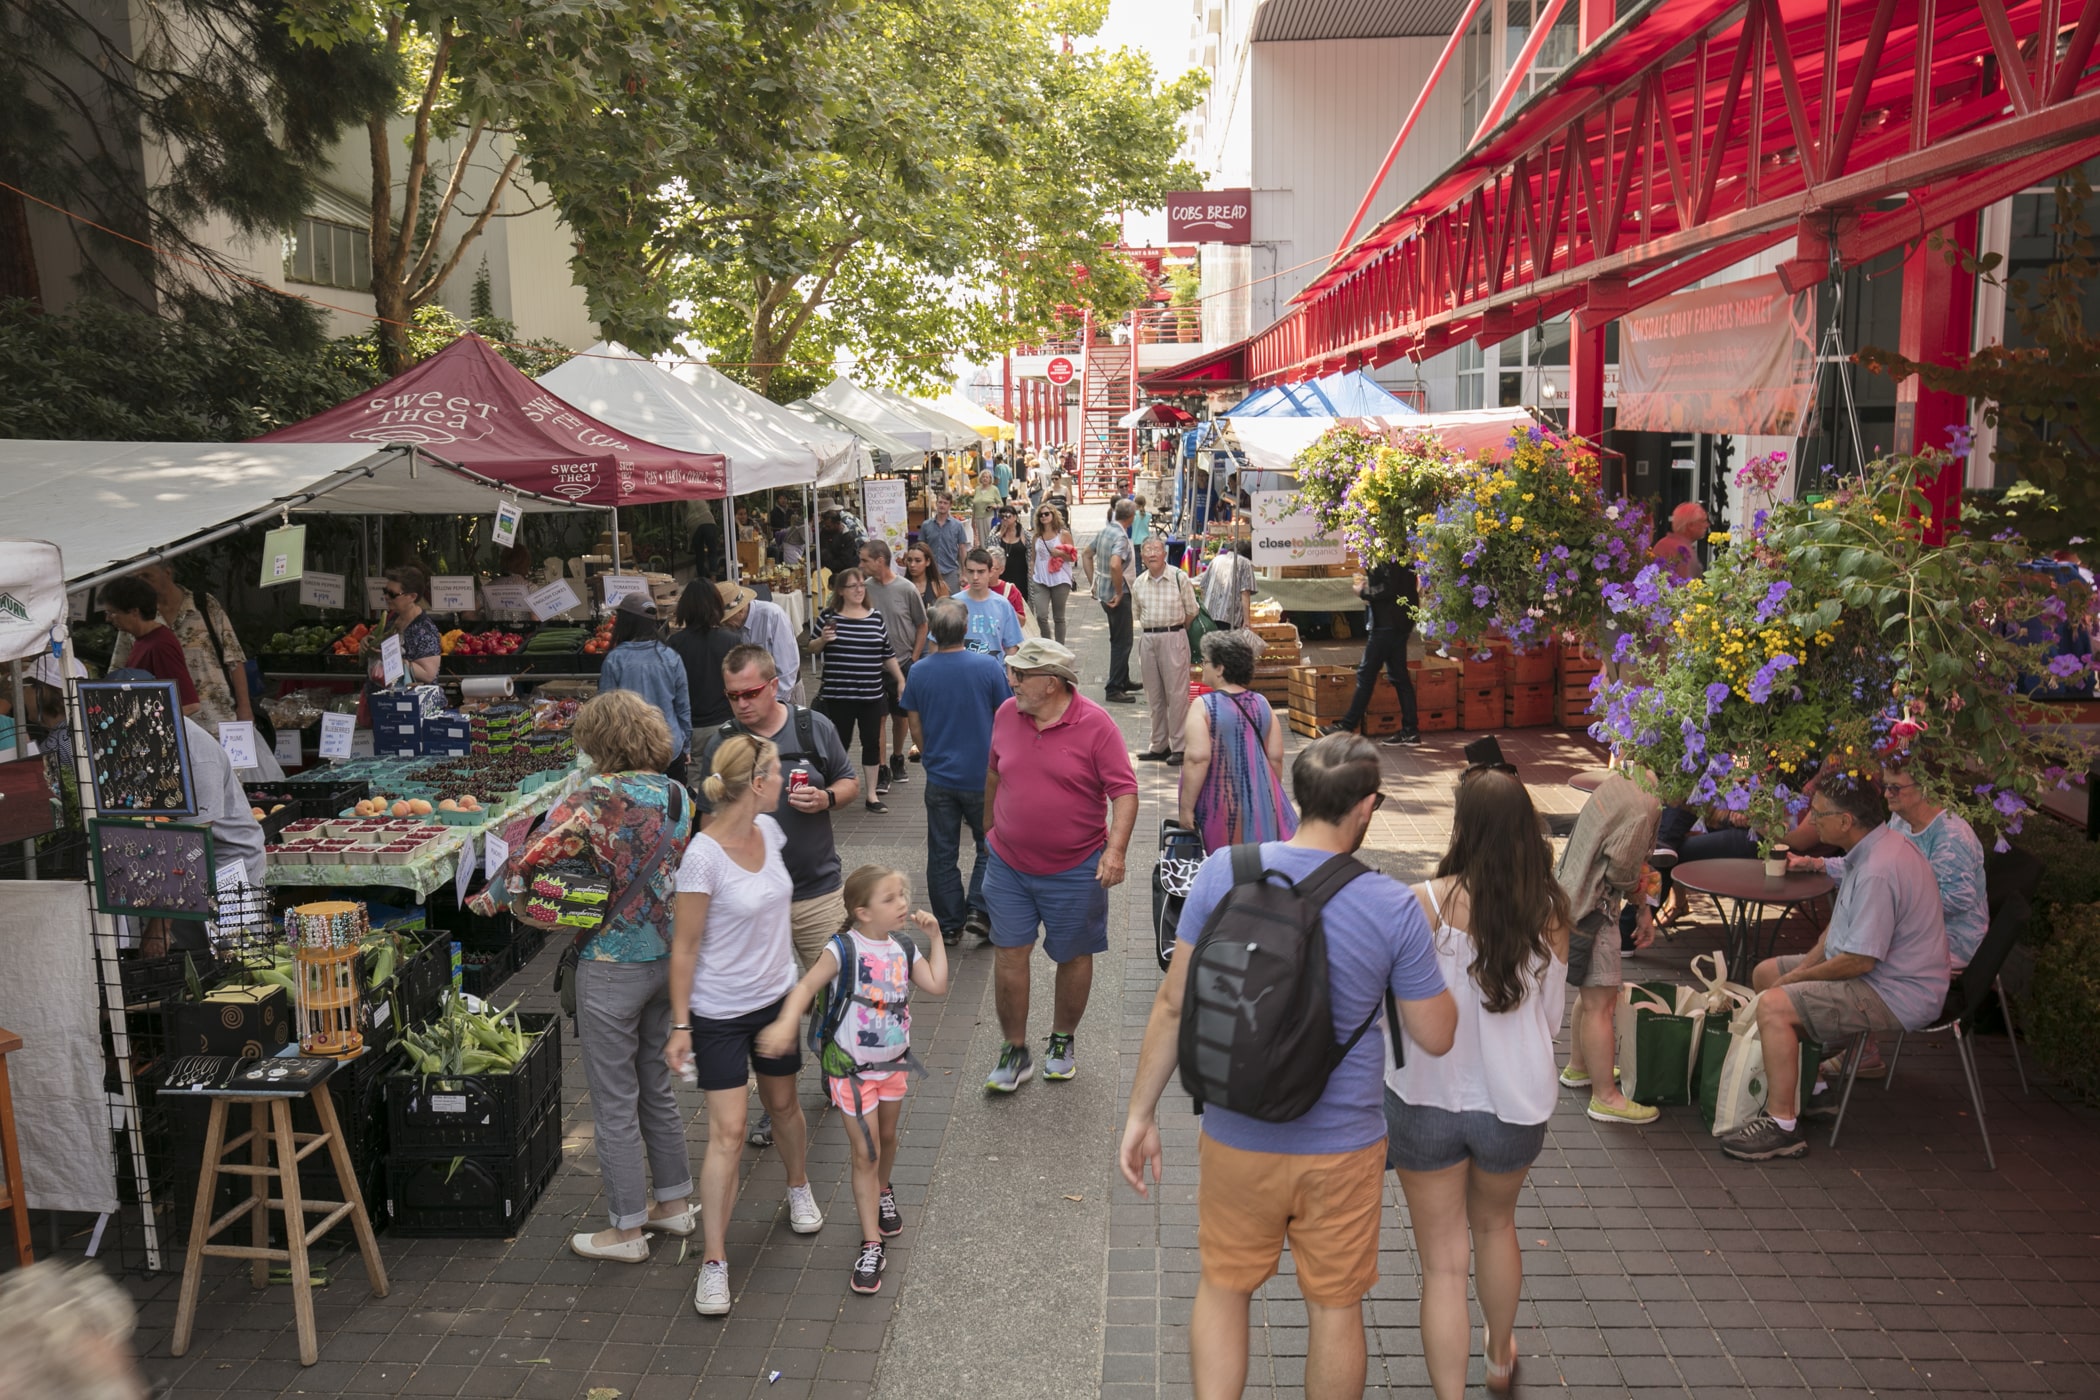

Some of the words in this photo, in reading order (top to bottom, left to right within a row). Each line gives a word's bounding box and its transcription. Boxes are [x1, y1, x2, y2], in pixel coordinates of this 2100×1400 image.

[1172, 205, 1203, 221] COBS
[1207, 204, 1247, 220] BREAD
[1630, 315, 1669, 343] LONSDALE
[1670, 309, 1693, 338] QUAY
[1694, 301, 1734, 334] FARMERS
[1735, 295, 1774, 327] MARKET
[320, 582, 342, 590] PEPPERS
